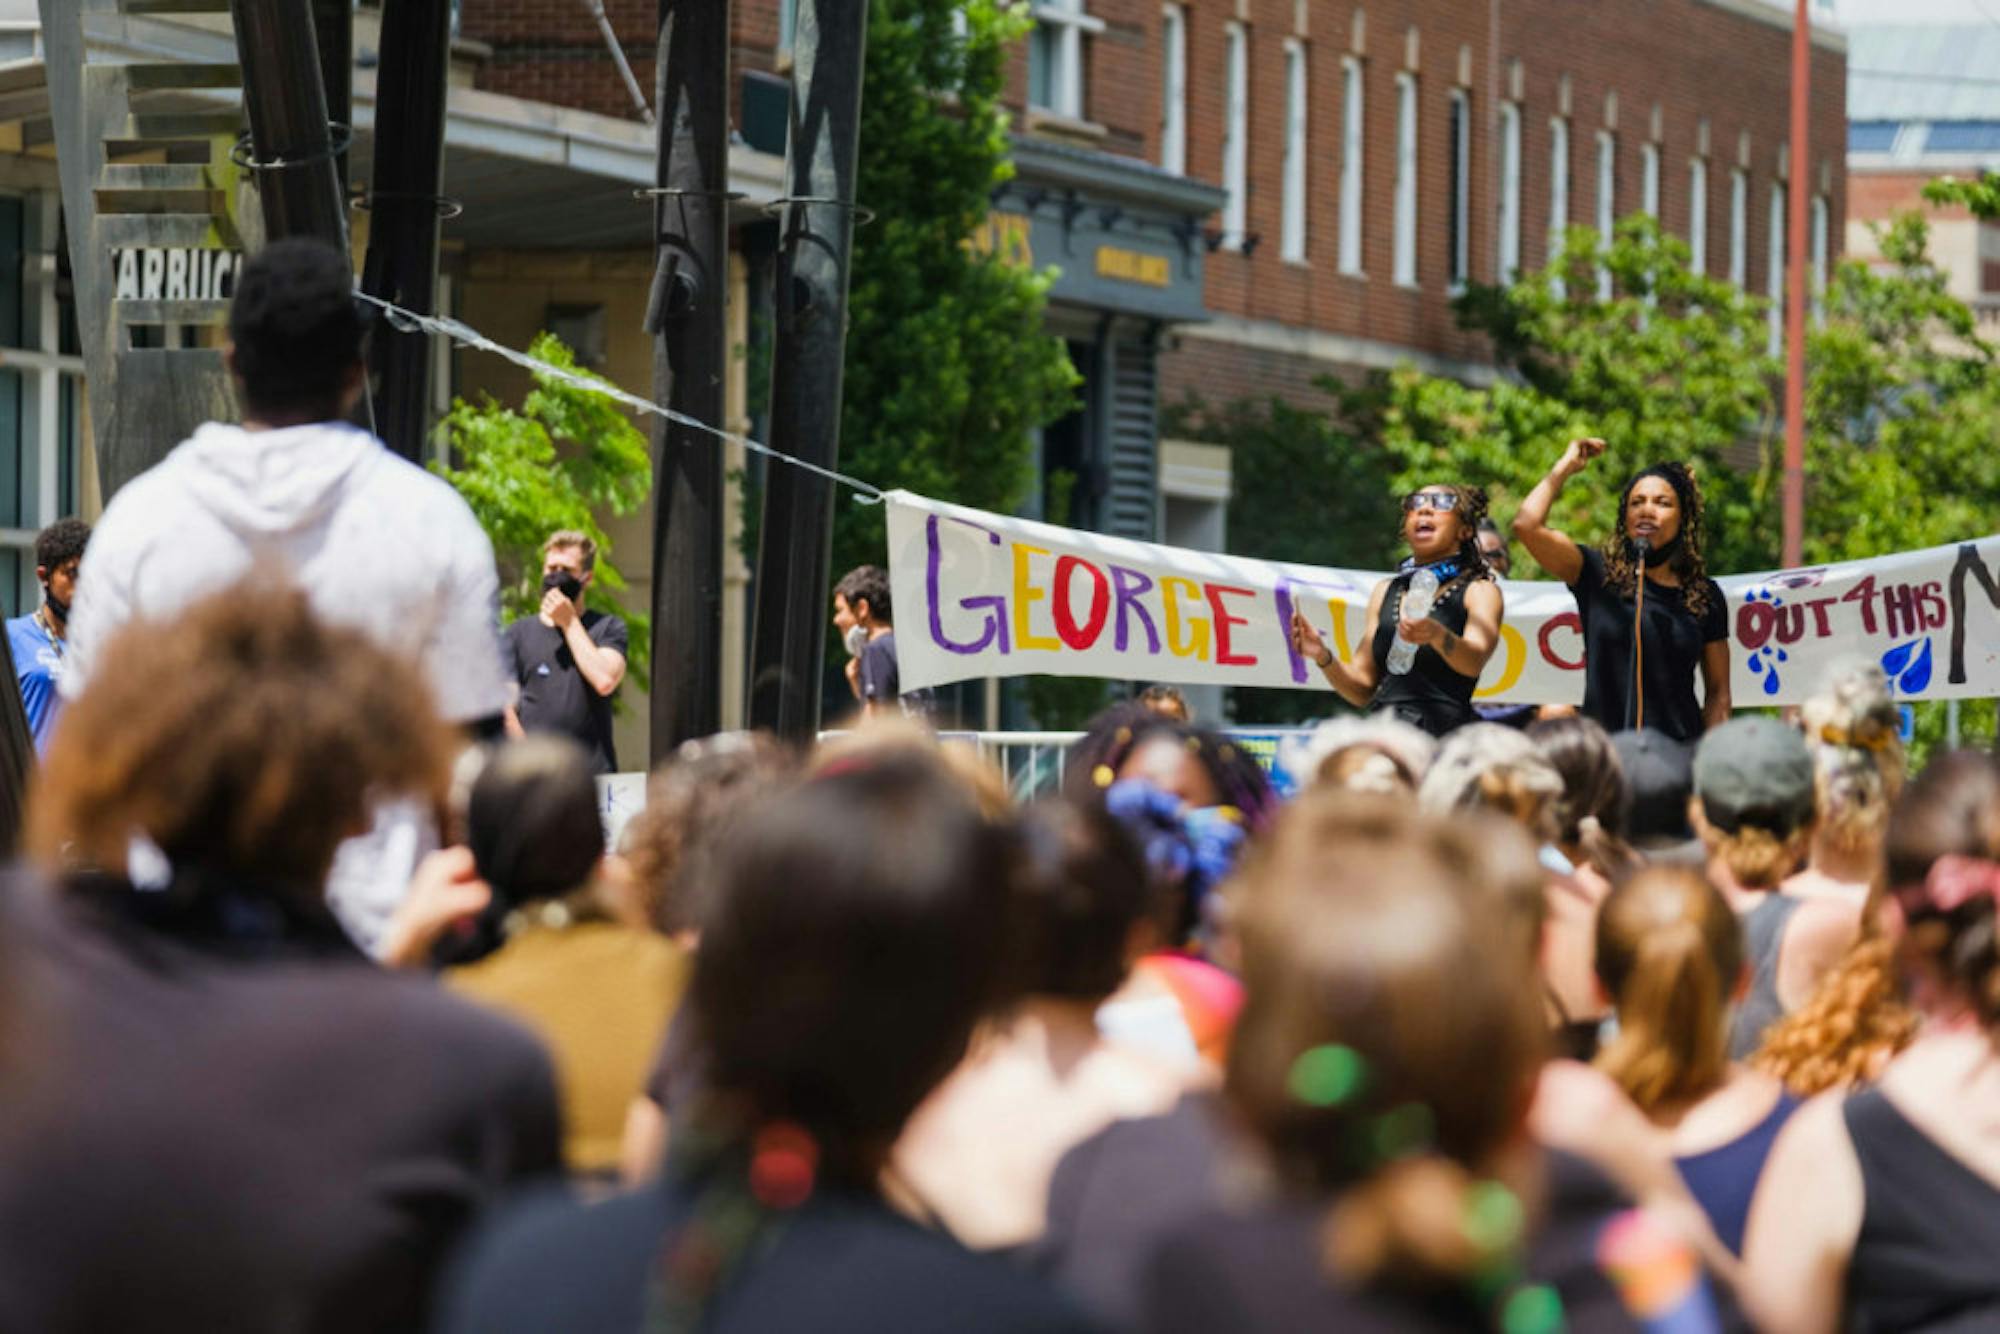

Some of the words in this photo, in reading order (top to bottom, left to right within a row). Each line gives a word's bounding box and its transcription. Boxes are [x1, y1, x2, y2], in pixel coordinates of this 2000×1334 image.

[112, 247, 243, 301] ARBUC
[926, 514, 1257, 665] GEORGE
[1736, 596, 1838, 650] OUT
